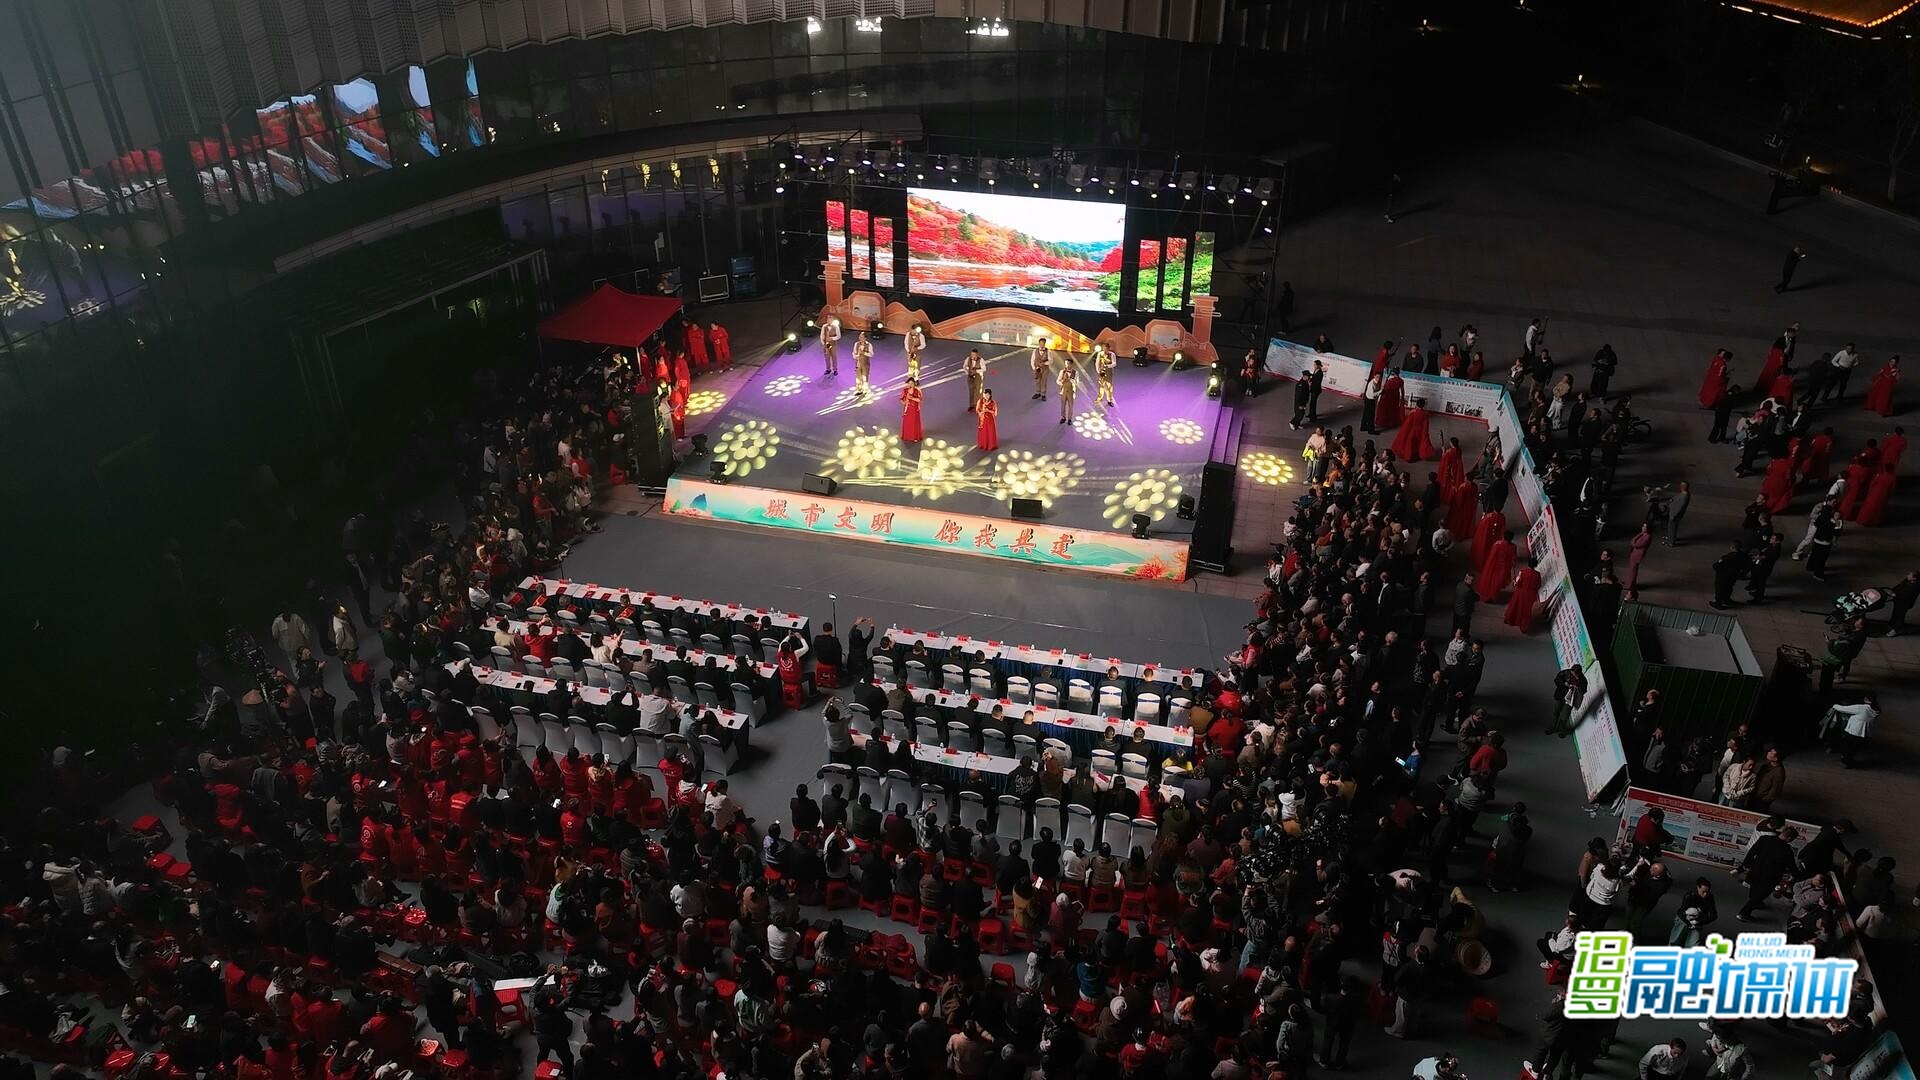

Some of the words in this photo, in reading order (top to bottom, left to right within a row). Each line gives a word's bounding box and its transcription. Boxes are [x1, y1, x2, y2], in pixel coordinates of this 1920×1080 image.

[764, 499, 894, 534] 城市文明
[934, 519, 1075, 560] 你我共建
